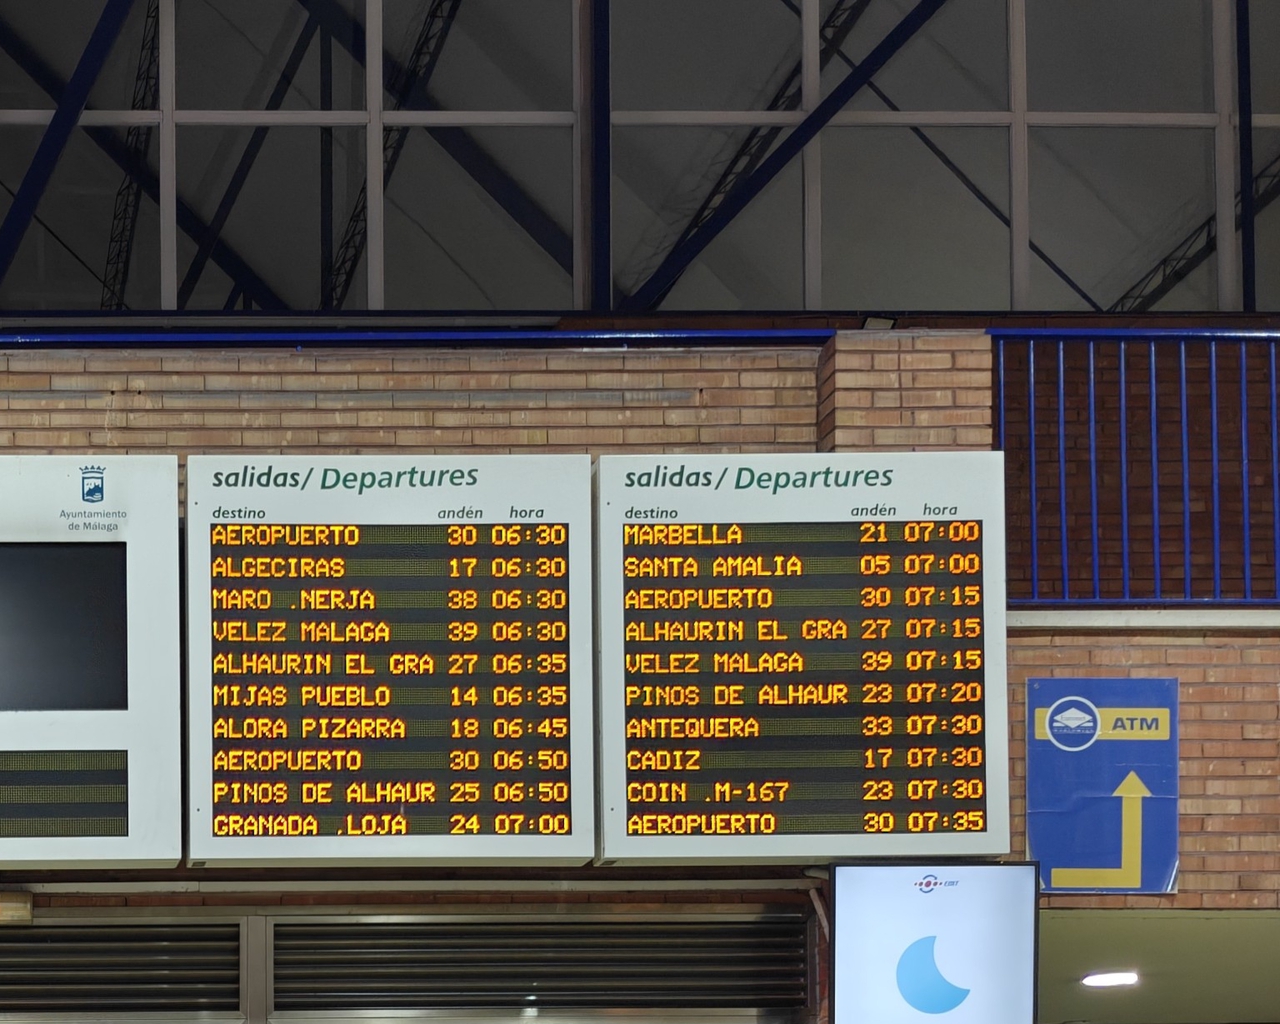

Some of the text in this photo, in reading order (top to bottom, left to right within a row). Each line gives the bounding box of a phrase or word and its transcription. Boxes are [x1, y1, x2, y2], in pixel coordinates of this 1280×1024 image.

[320, 466, 479, 495] Departures
[734, 466, 893, 495] Departures
[59, 510, 127, 520] Ayuntamiento
[212, 505, 544, 519] destino andén hora
[68, 521, 119, 532] de Málaga
[212, 556, 566, 578] ALGECIRAS 17 06:30
[624, 553, 980, 578] SANTA AMALIA 05 07:00
[212, 588, 272, 610] MARO
[448, 589, 478, 609] 38
[491, 589, 567, 609] 06:30
[1112, 717, 1159, 731] ATM
[626, 746, 983, 770] CADIZ 17 07:30
[627, 782, 687, 802] COIN
[862, 780, 894, 801] 23
[907, 779, 984, 800] 07:30
[213, 814, 318, 836] GRANADA
[450, 814, 481, 834] 24
[494, 814, 570, 834] 07:00
